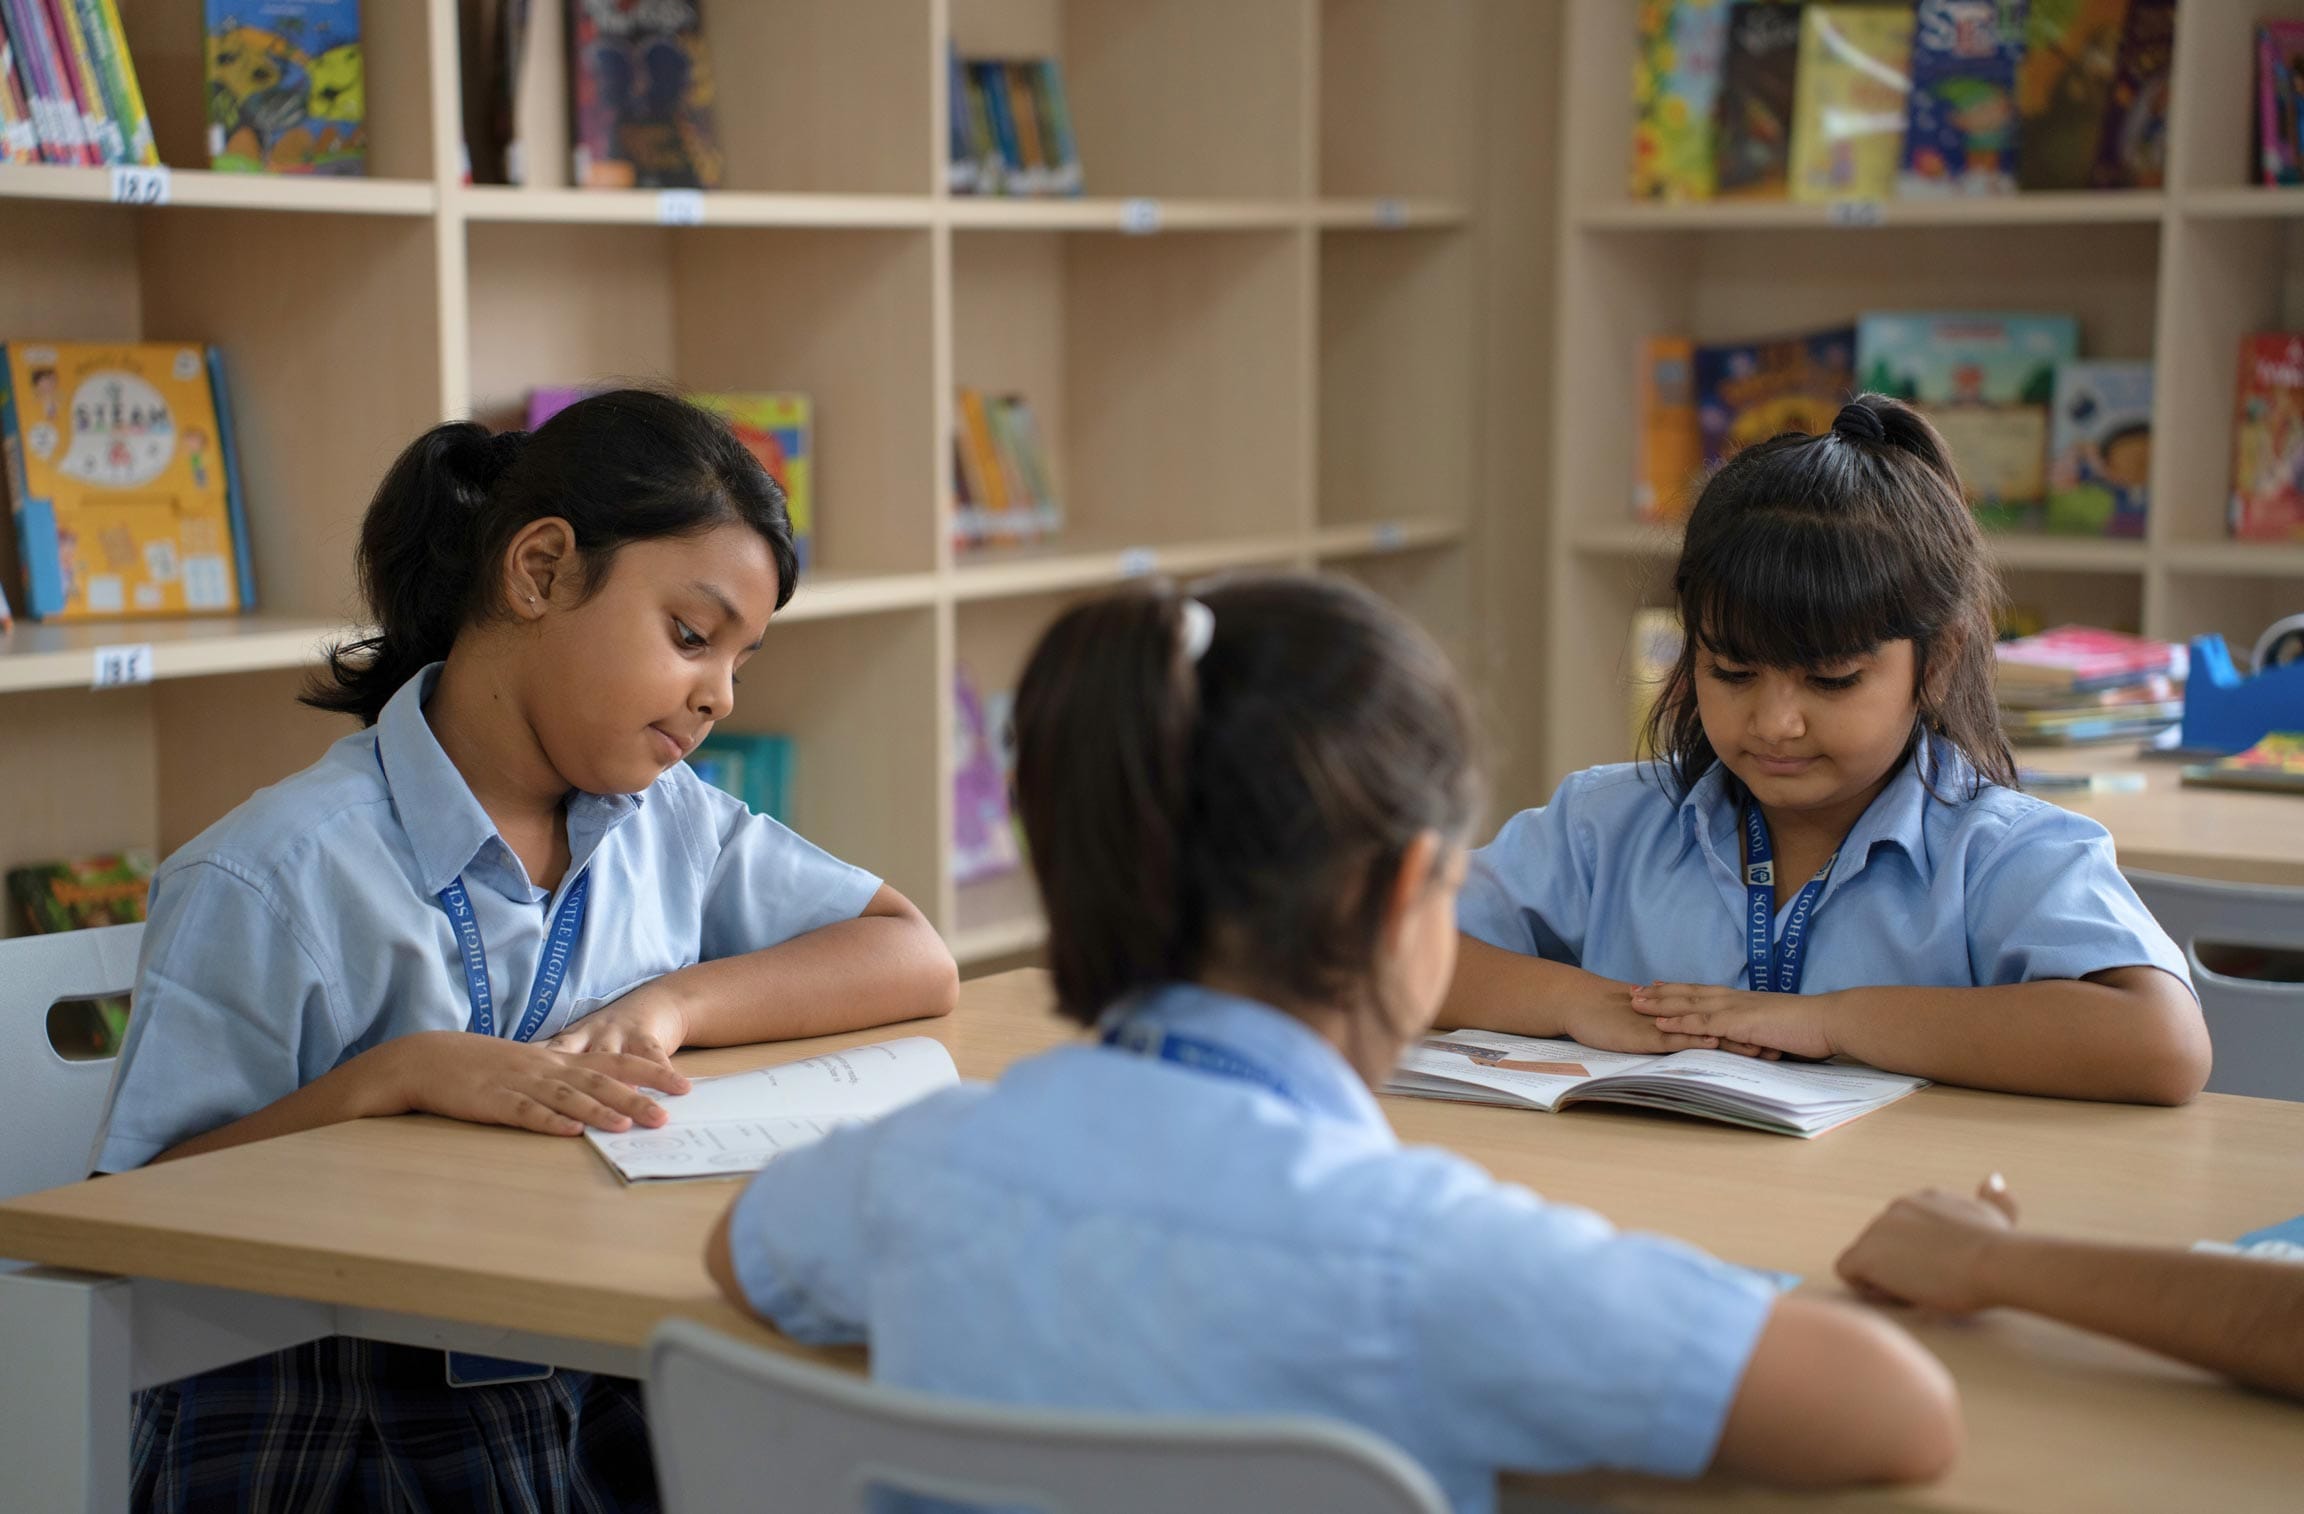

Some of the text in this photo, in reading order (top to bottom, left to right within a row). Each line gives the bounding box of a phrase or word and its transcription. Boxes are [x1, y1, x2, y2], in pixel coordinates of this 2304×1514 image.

[76, 403, 171, 434] STEAM
[461, 921, 484, 970] HIGH
[1753, 892, 1767, 961] SCOTLE
[1785, 889, 1816, 959] SCHOOL
[546, 941, 569, 986] HIGH
